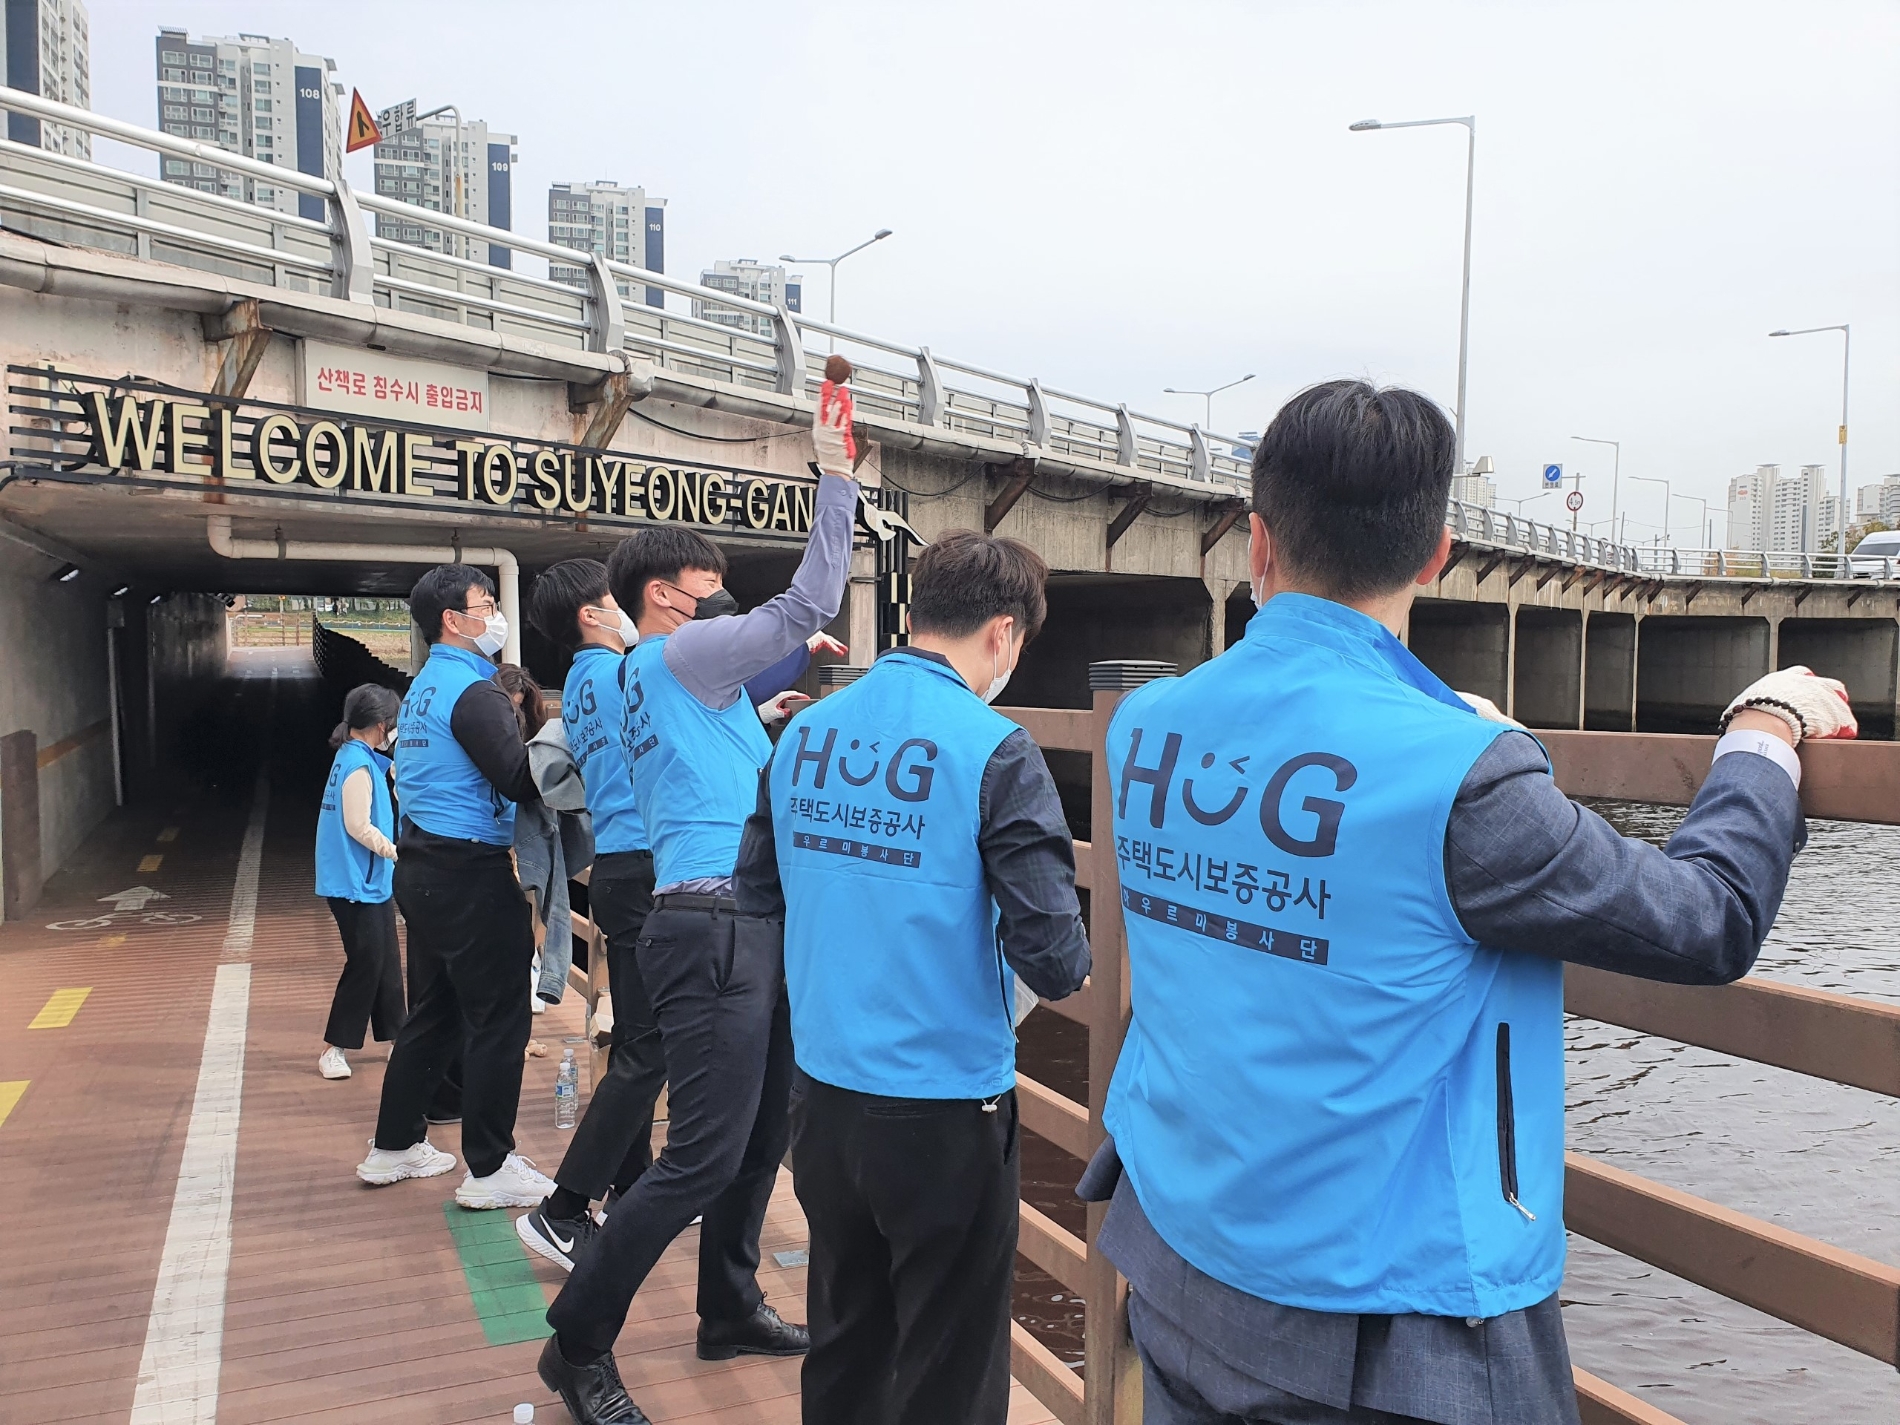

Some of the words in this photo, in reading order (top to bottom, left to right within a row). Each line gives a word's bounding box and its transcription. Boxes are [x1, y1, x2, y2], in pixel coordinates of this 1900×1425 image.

[299, 87, 320, 99] 108
[382, 100, 415, 137] 우합류
[491, 161, 509, 172] 109
[649, 223, 661, 232] 110
[787, 298, 797, 306] 111
[317, 367, 367, 396] 산책로
[373, 375, 419, 405] 침수시
[425, 383, 483, 414] 출입금지
[92, 391, 435, 496] WELCOME
[453, 440, 518, 505] TO
[531, 450, 815, 532] SUYEONG-GAN
[791, 726, 939, 802] HUG
[1118, 727, 1358, 858] HUG
[790, 797, 926, 840] 주택도시보증공사
[799, 834, 915, 866] 우르미봉사단
[1117, 834, 1332, 920] 주택도시보증공사
